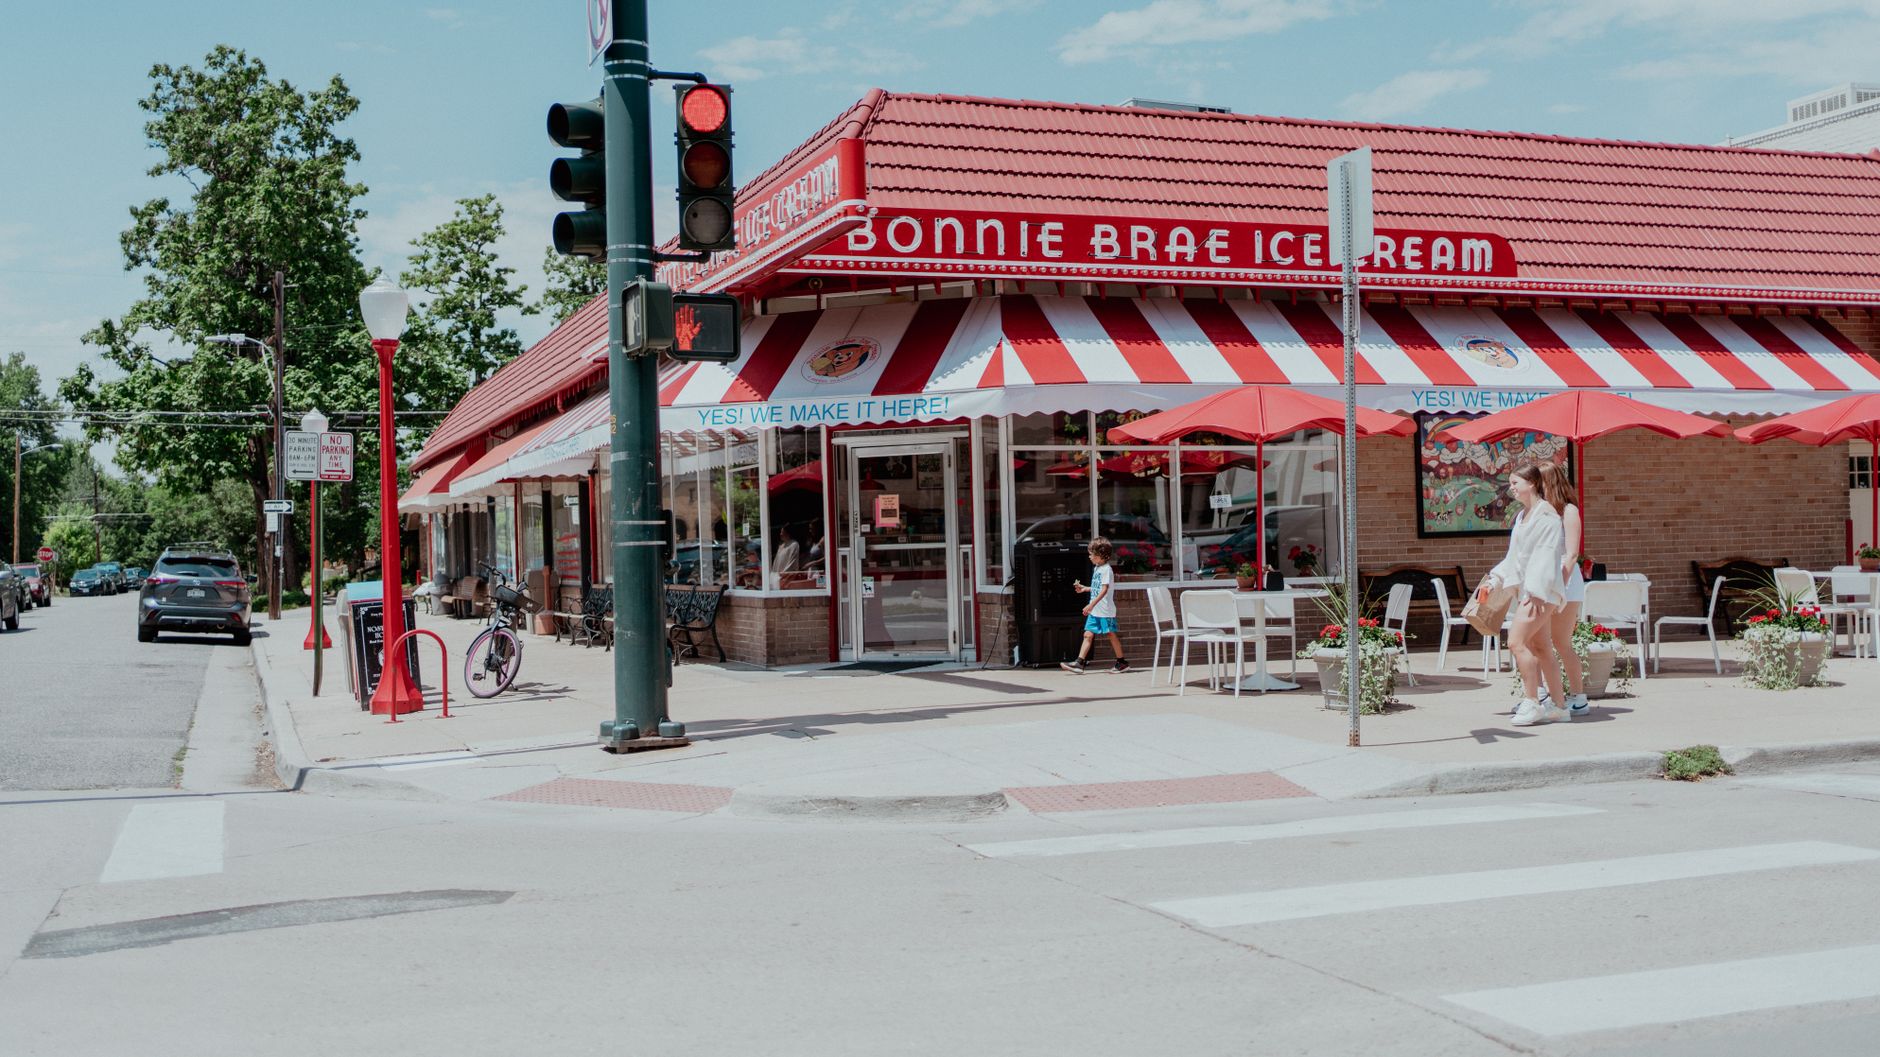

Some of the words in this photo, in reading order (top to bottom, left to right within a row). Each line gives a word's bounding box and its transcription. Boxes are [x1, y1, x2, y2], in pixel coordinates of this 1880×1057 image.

[845, 214, 1064, 258] BONNIE
[1090, 224, 1231, 264] BRAE
[1254, 230, 1323, 267] ICE
[1353, 234, 1493, 273] REAM
[1412, 389, 1456, 408] YES!
[1462, 390, 1492, 408] WE
[697, 408, 744, 426] YES!
[750, 405, 783, 424] WE
[789, 402, 849, 422] MAKE
[857, 401, 876, 419] IT
[882, 397, 949, 417] HERE!
[330, 435, 342, 445] NO
[288, 445, 316, 453] PARKING
[321, 445, 350, 456] PARKING
[328, 461, 344, 469] TIME
